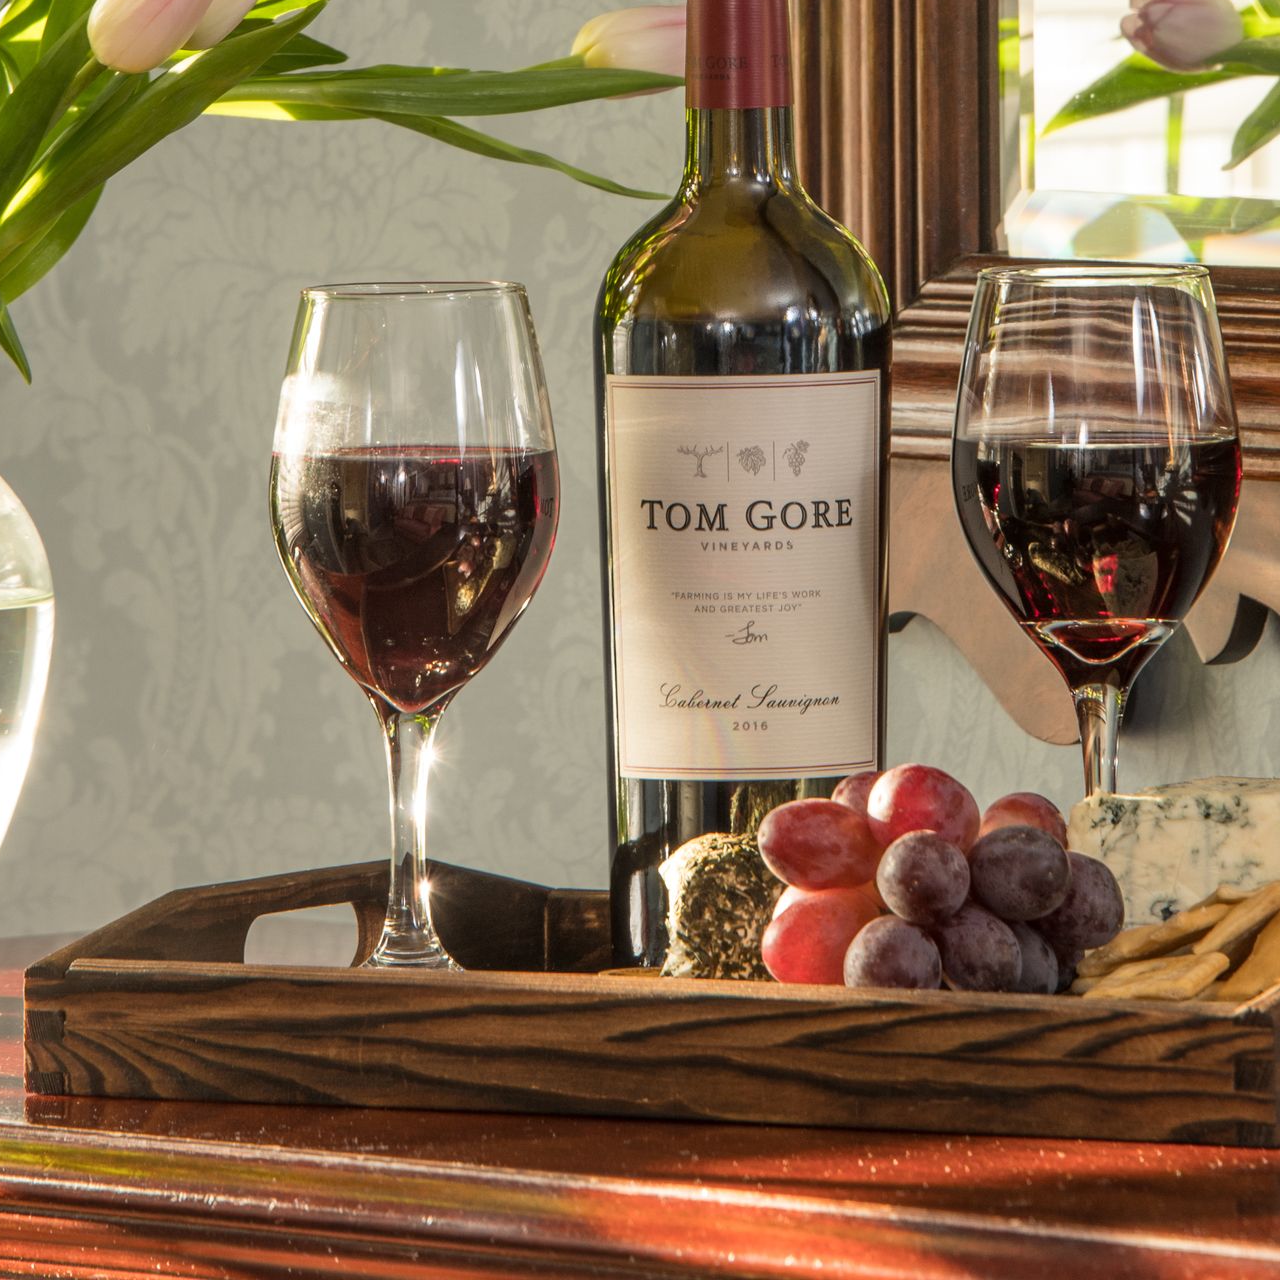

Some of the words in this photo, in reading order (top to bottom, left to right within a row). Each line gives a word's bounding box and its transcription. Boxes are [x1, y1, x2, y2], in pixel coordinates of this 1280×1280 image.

[640, 498, 730, 532] TOM
[745, 498, 853, 532] GORE
[700, 540, 794, 552] VINEYARDS
[723, 591, 733, 600] IS
[737, 591, 753, 600] MY
[756, 590, 788, 600] LIFE'S
[791, 589, 822, 599] WORK
[694, 604, 716, 614] AND
[720, 604, 774, 614] GREATEST
[659, 682, 742, 710] Cabernet
[746, 683, 840, 715] Sauvignon
[732, 721, 769, 732] 2016
